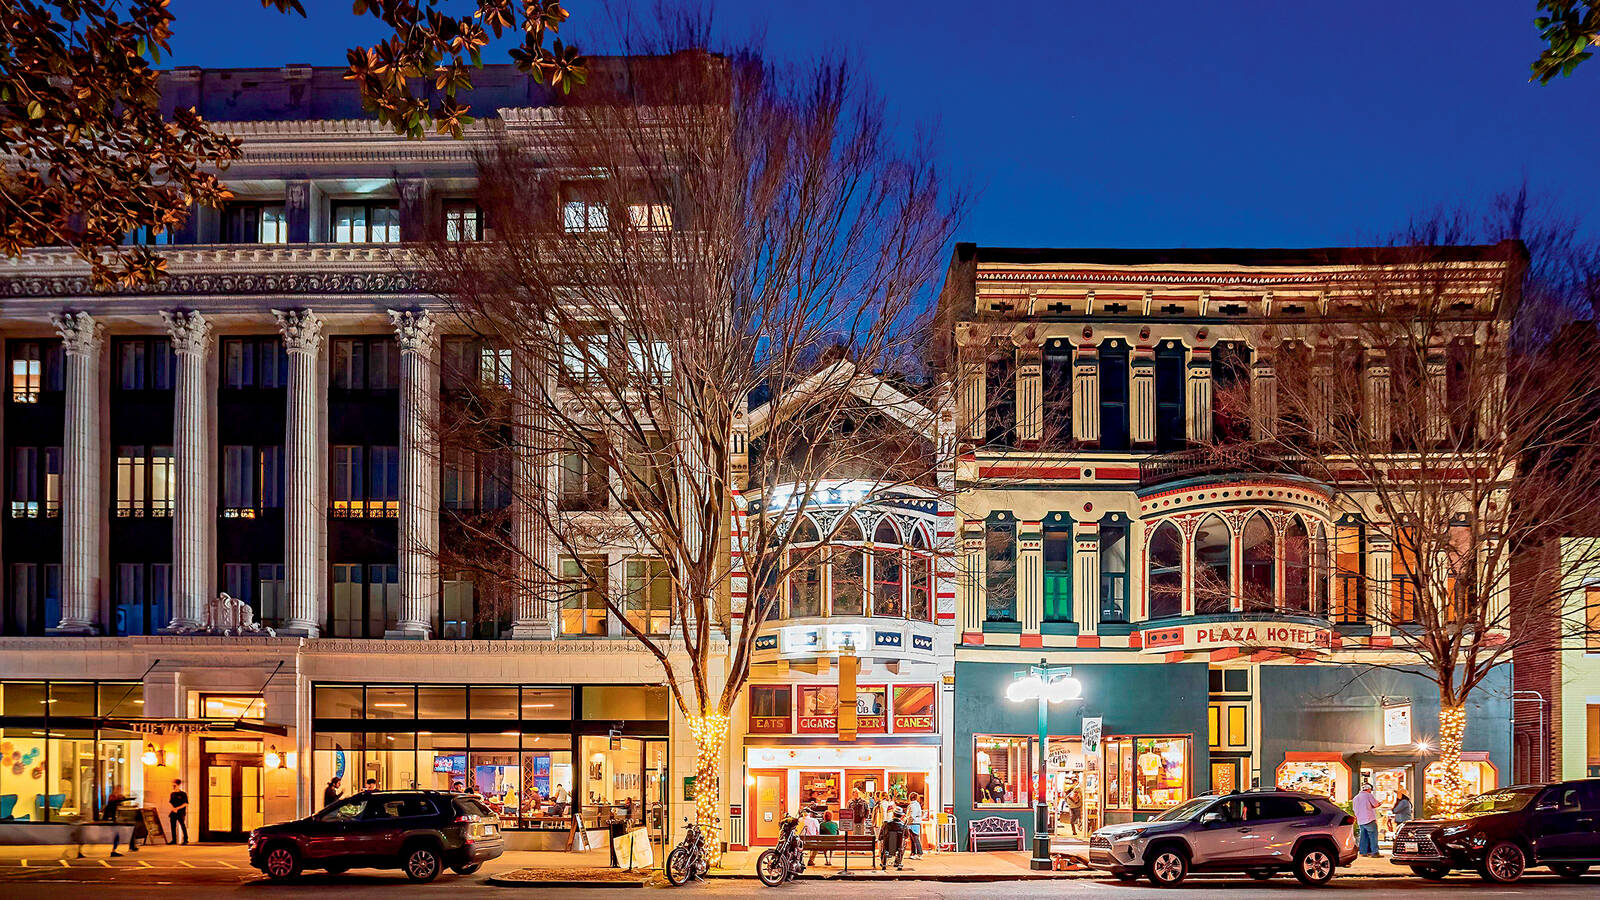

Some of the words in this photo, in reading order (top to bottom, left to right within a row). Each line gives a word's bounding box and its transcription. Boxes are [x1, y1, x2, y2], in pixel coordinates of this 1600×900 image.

[1196, 627, 1257, 644] PLAZA
[1267, 627, 1310, 643] HOTEL
[756, 719, 784, 728] EATS
[800, 718, 836, 728] CIGARS
[896, 717, 930, 728] CANES
